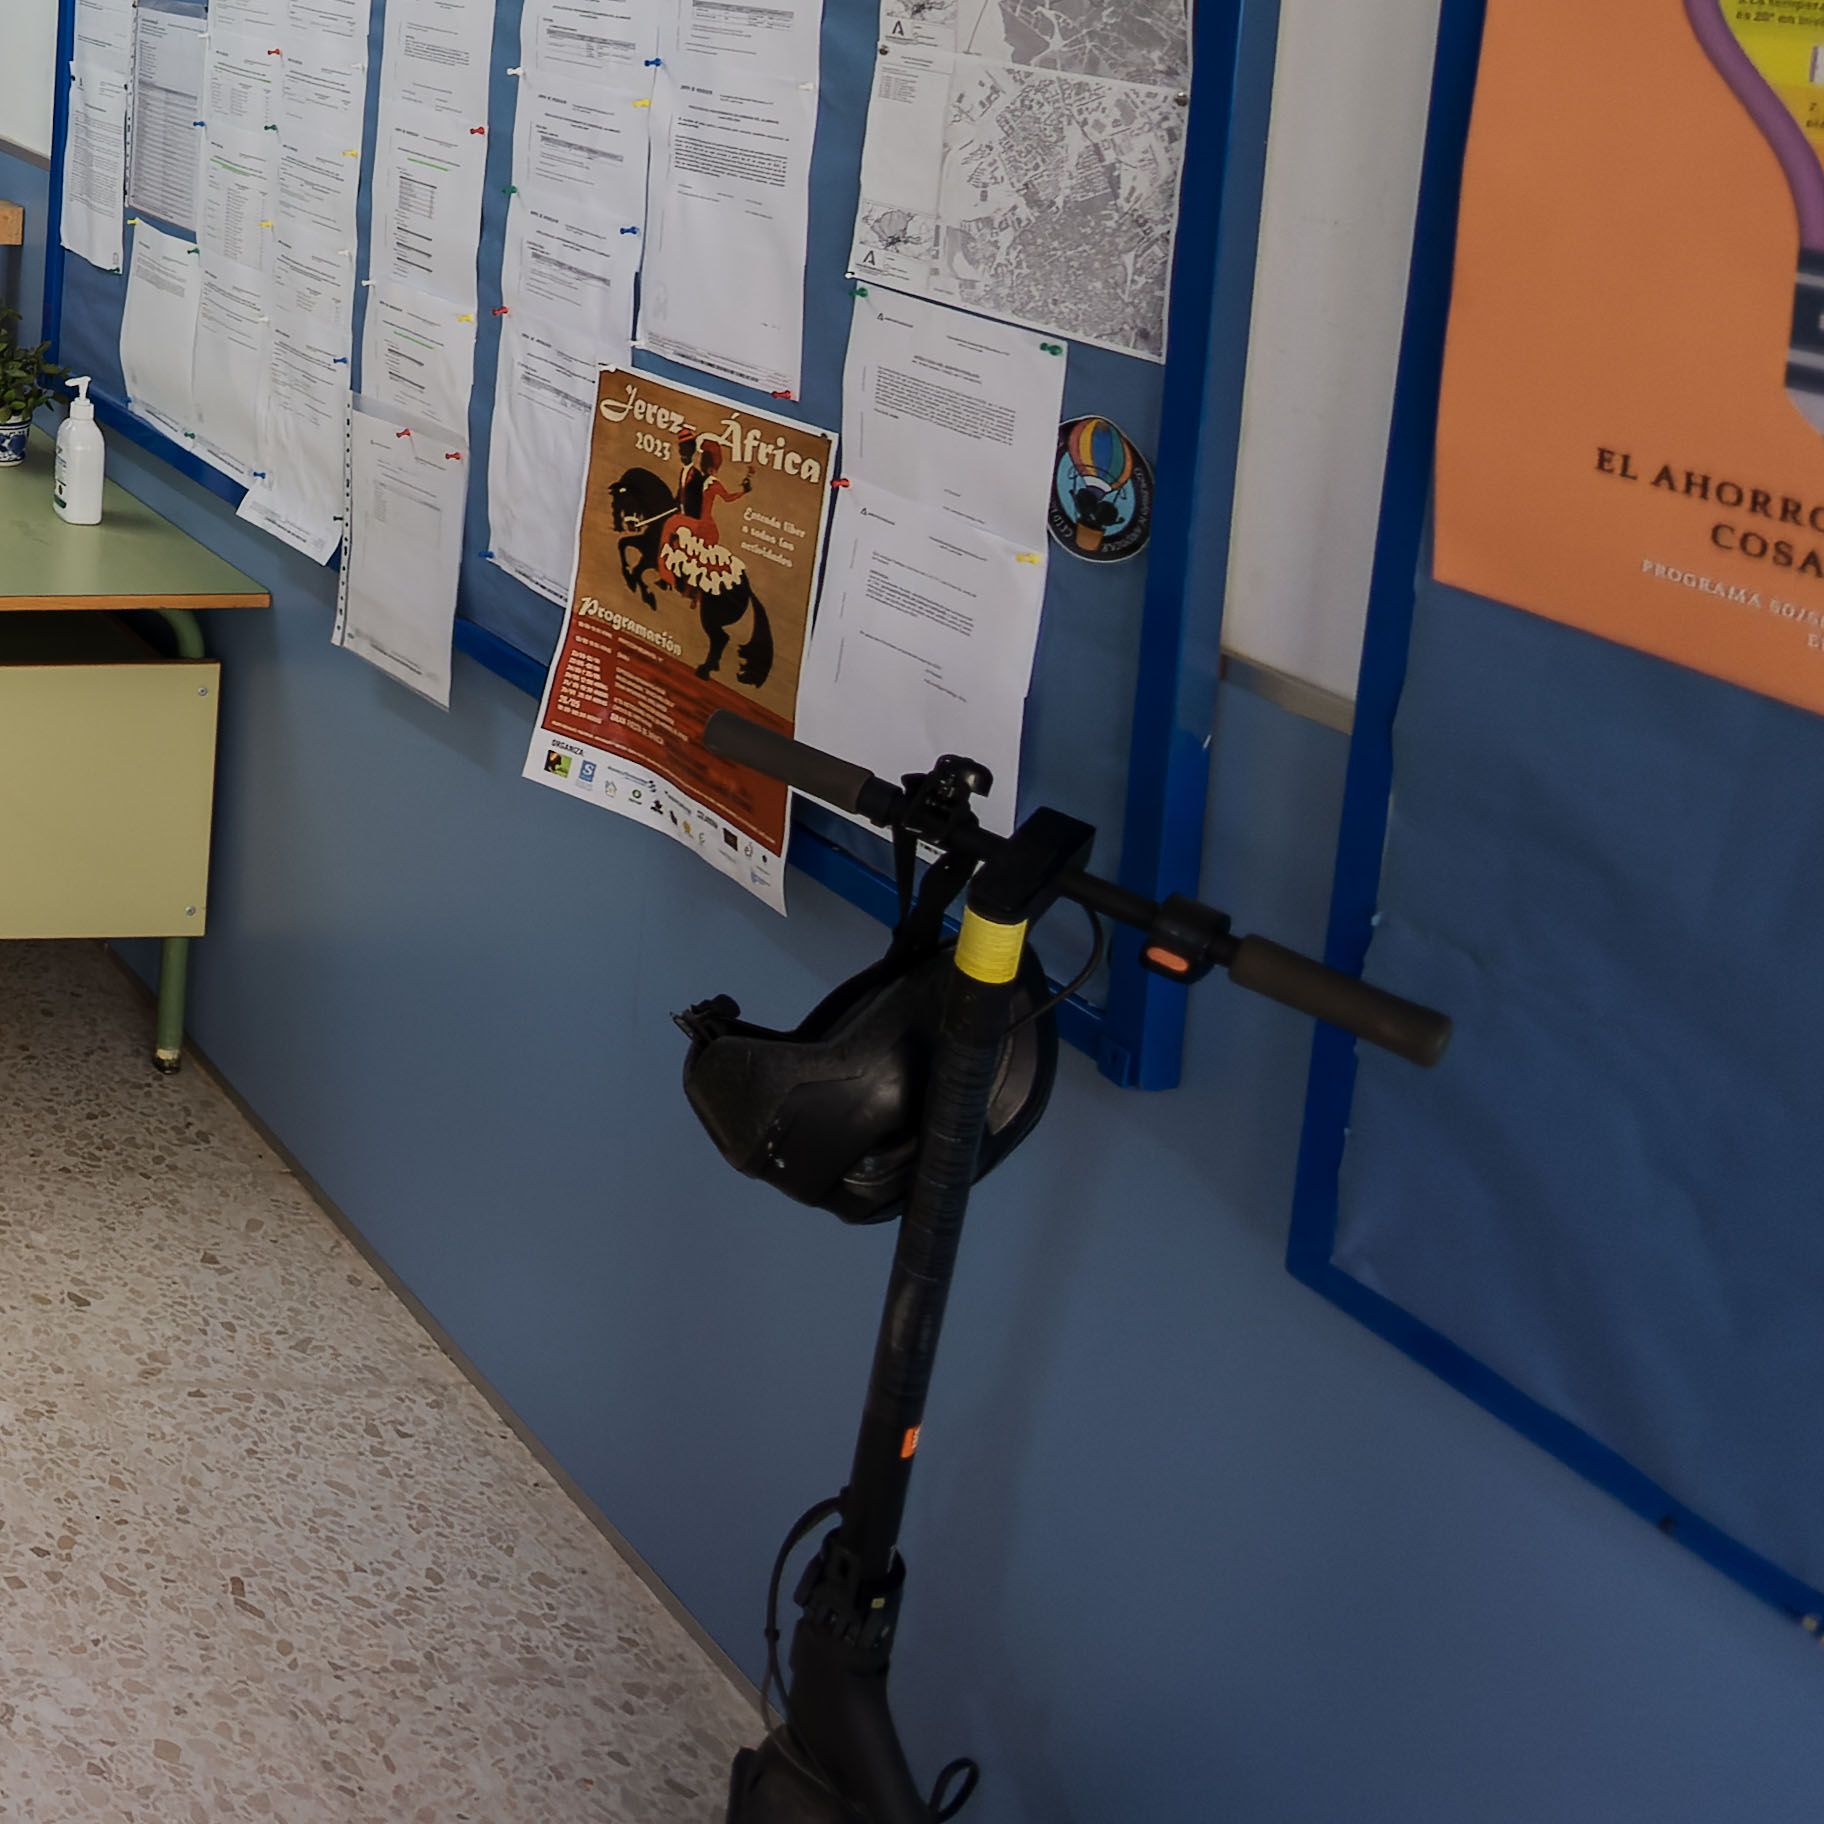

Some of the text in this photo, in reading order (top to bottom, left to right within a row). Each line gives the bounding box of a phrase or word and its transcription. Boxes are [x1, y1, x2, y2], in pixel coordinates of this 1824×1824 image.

[635, 431, 672, 461] 2023
[1595, 447, 1638, 479] EL
[1642, 559, 1761, 608] PROGRAMA
